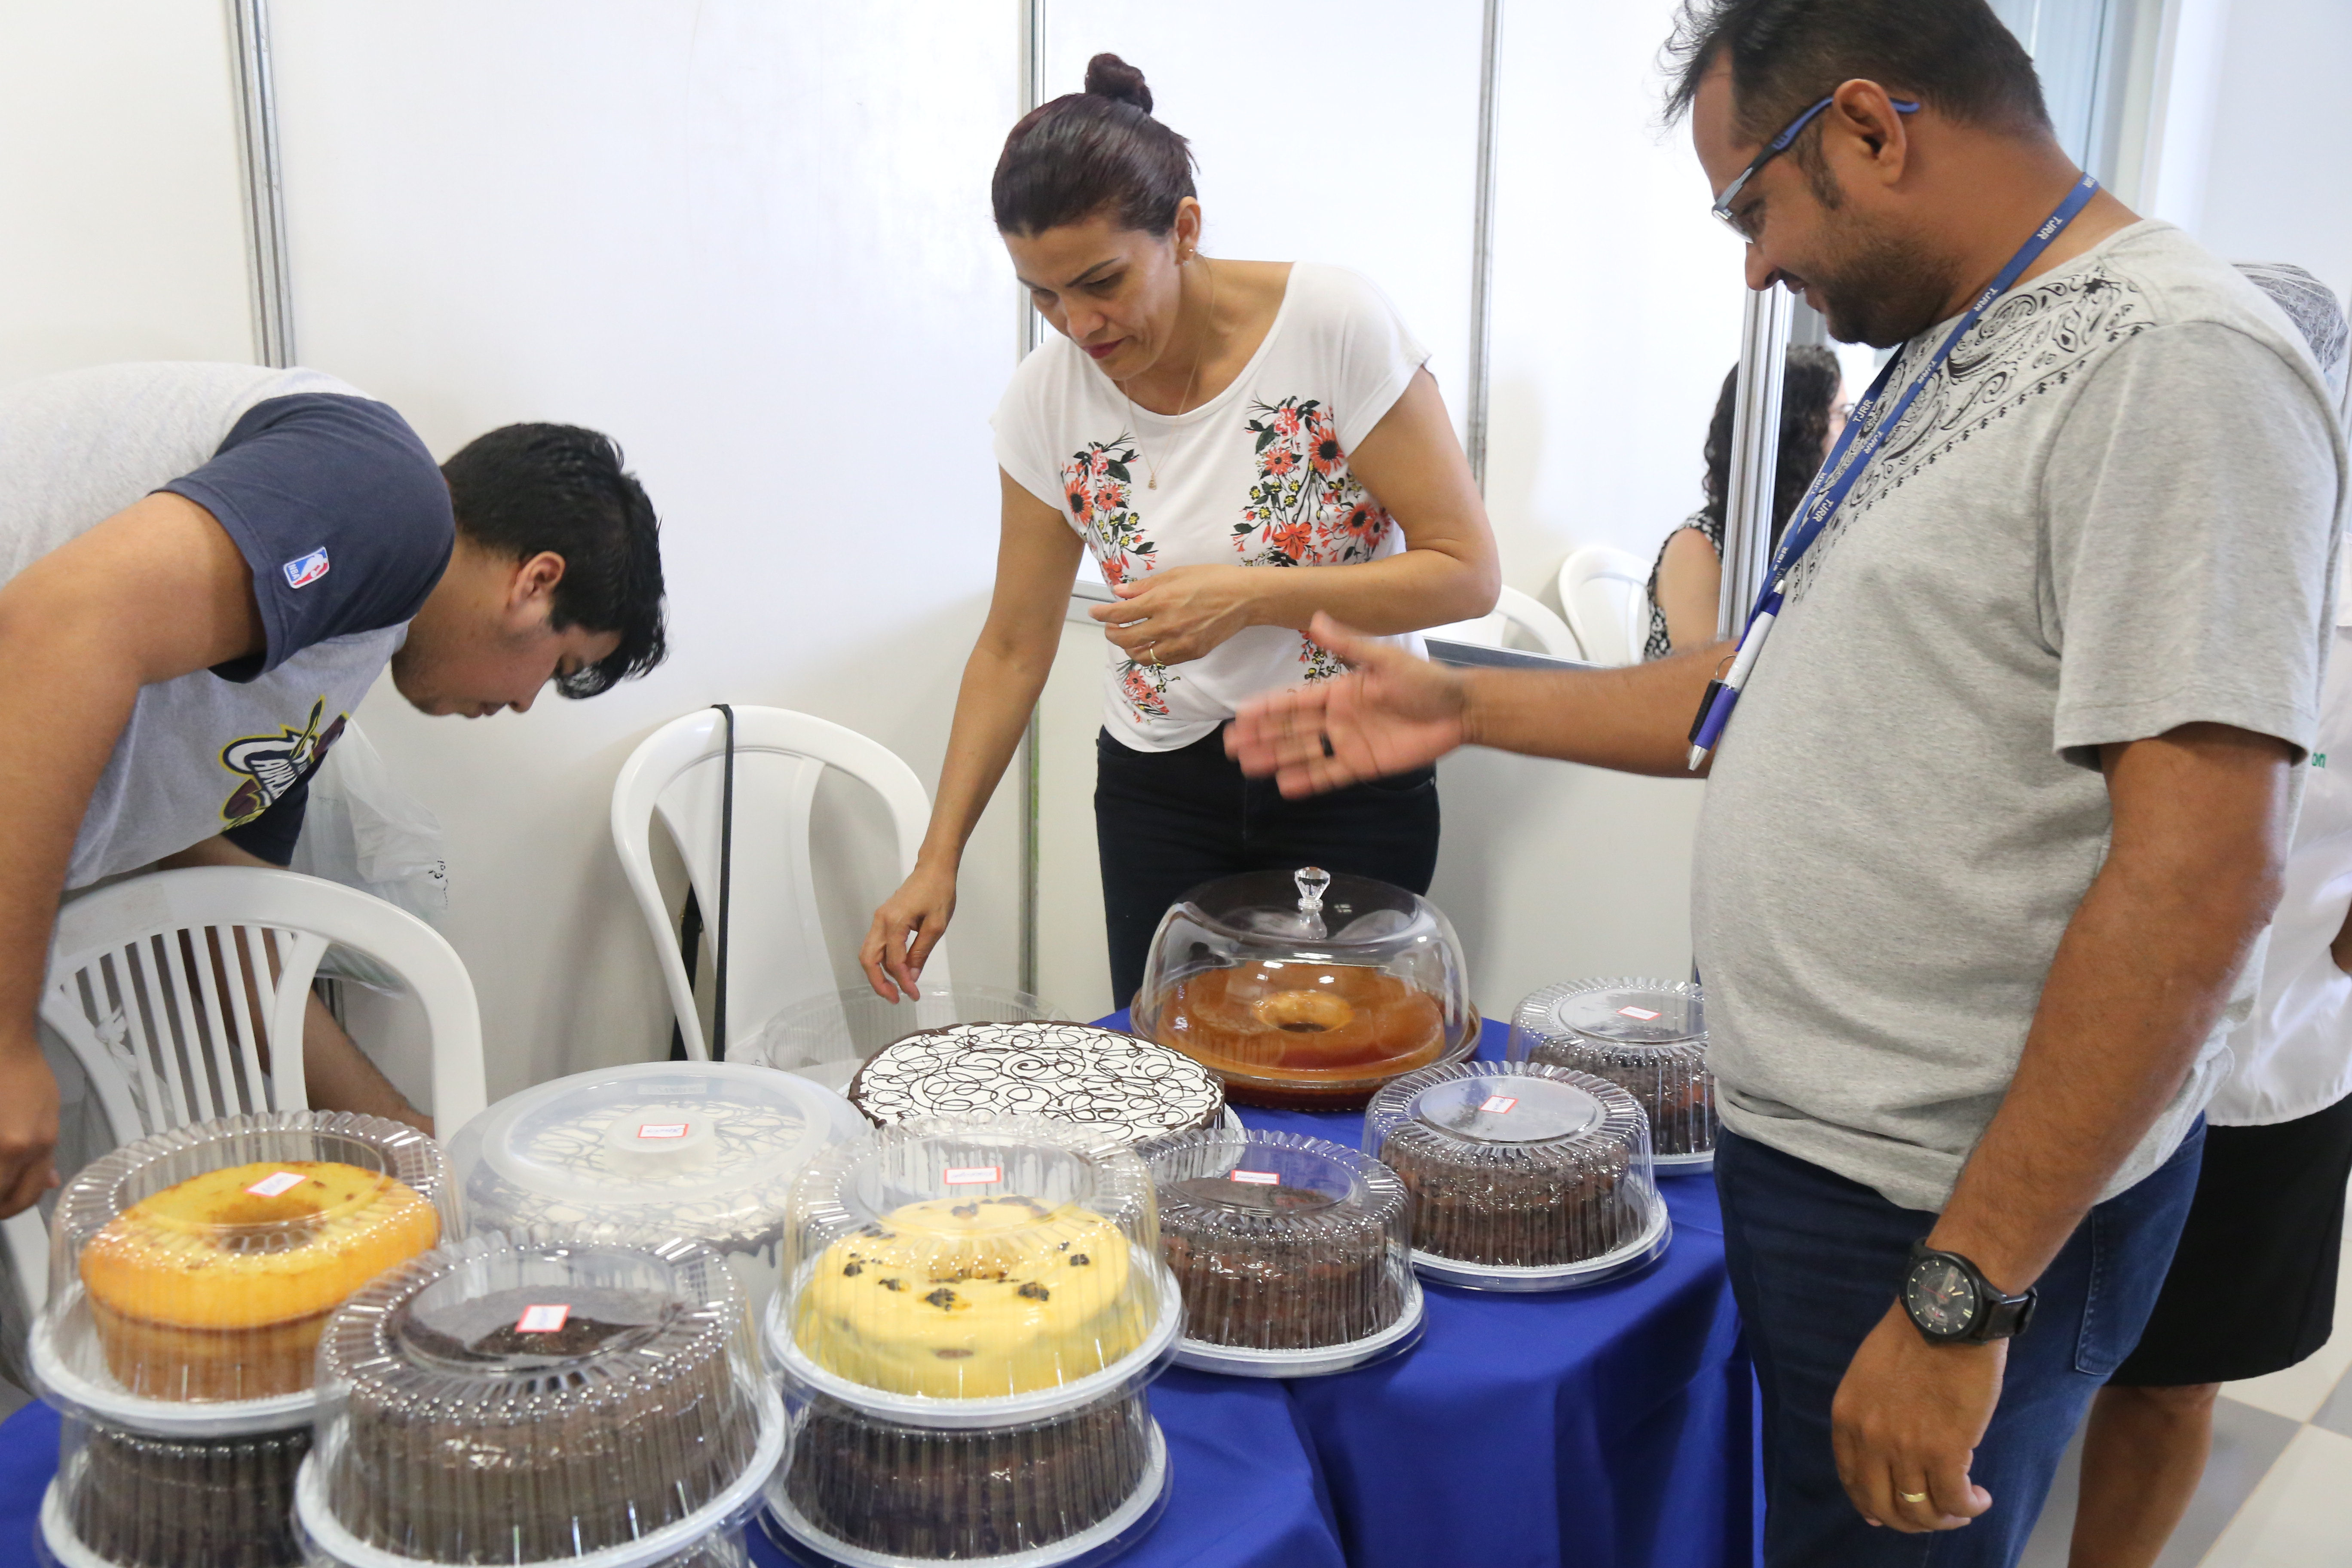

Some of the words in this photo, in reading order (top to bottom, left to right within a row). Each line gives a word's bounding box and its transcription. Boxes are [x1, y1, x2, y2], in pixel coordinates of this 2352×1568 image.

[2037, 216, 2064, 240] TJRR
[1973, 288, 1998, 312] TJRR
[1917, 361, 1938, 384] TJRR
[1852, 399, 1874, 423] TJRR
[1863, 431, 1884, 454] TJRR
[1812, 499, 1834, 522] TJRR
[288, 564, 300, 580] NBA
[658, 1085, 704, 1094] SANREMO
